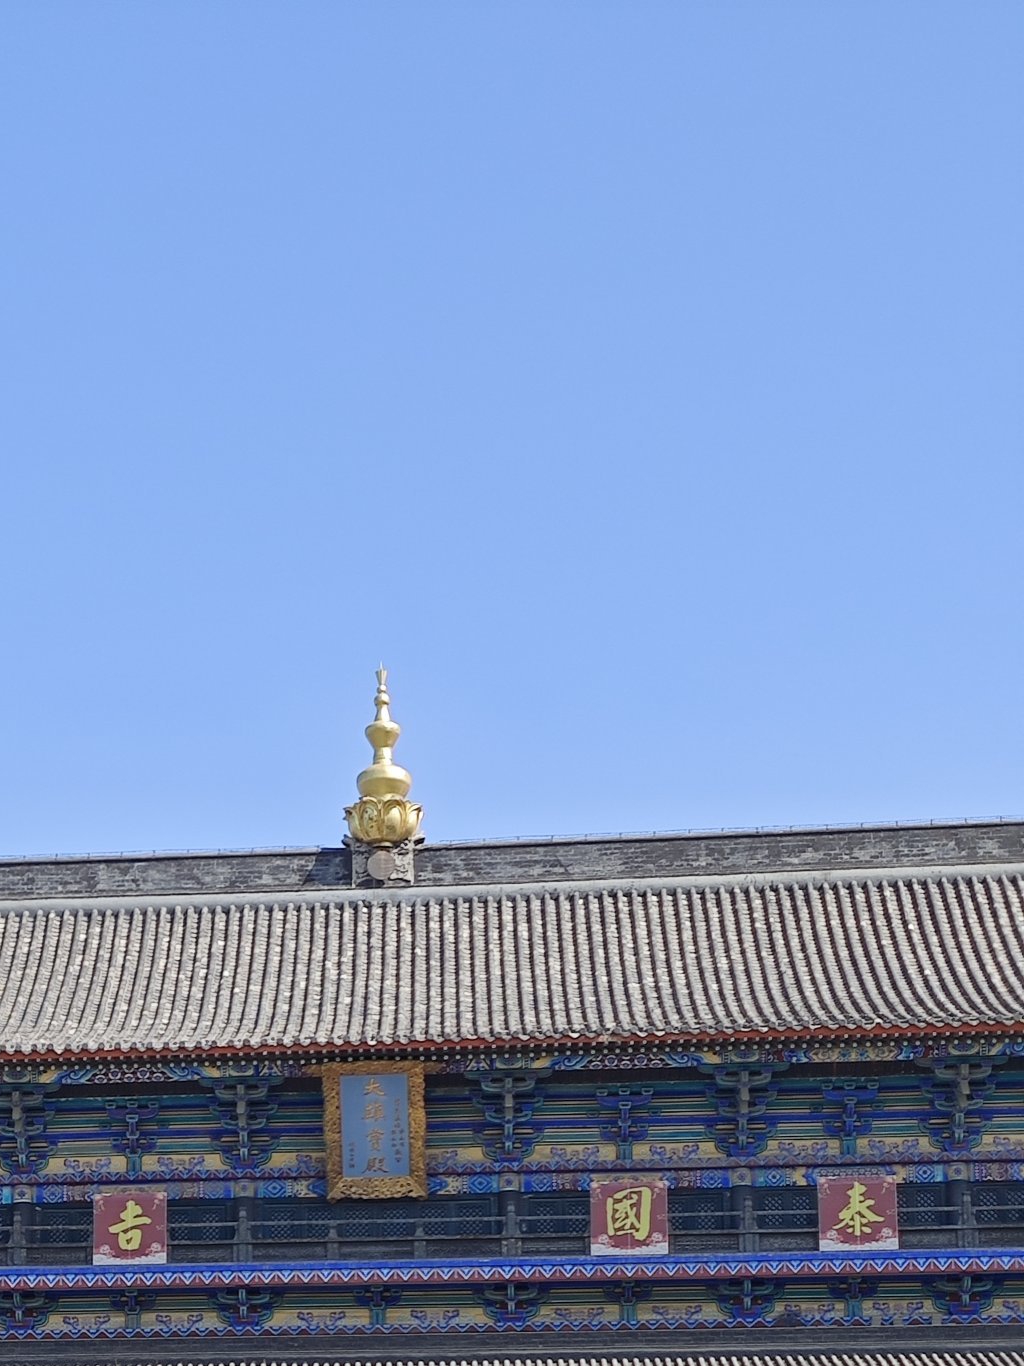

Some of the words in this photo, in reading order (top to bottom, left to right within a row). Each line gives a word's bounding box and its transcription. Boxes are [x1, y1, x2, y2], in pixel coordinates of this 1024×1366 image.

[107, 1199, 152, 1250] 吉
[606, 1185, 652, 1241] 國
[832, 1181, 885, 1236] 泰
